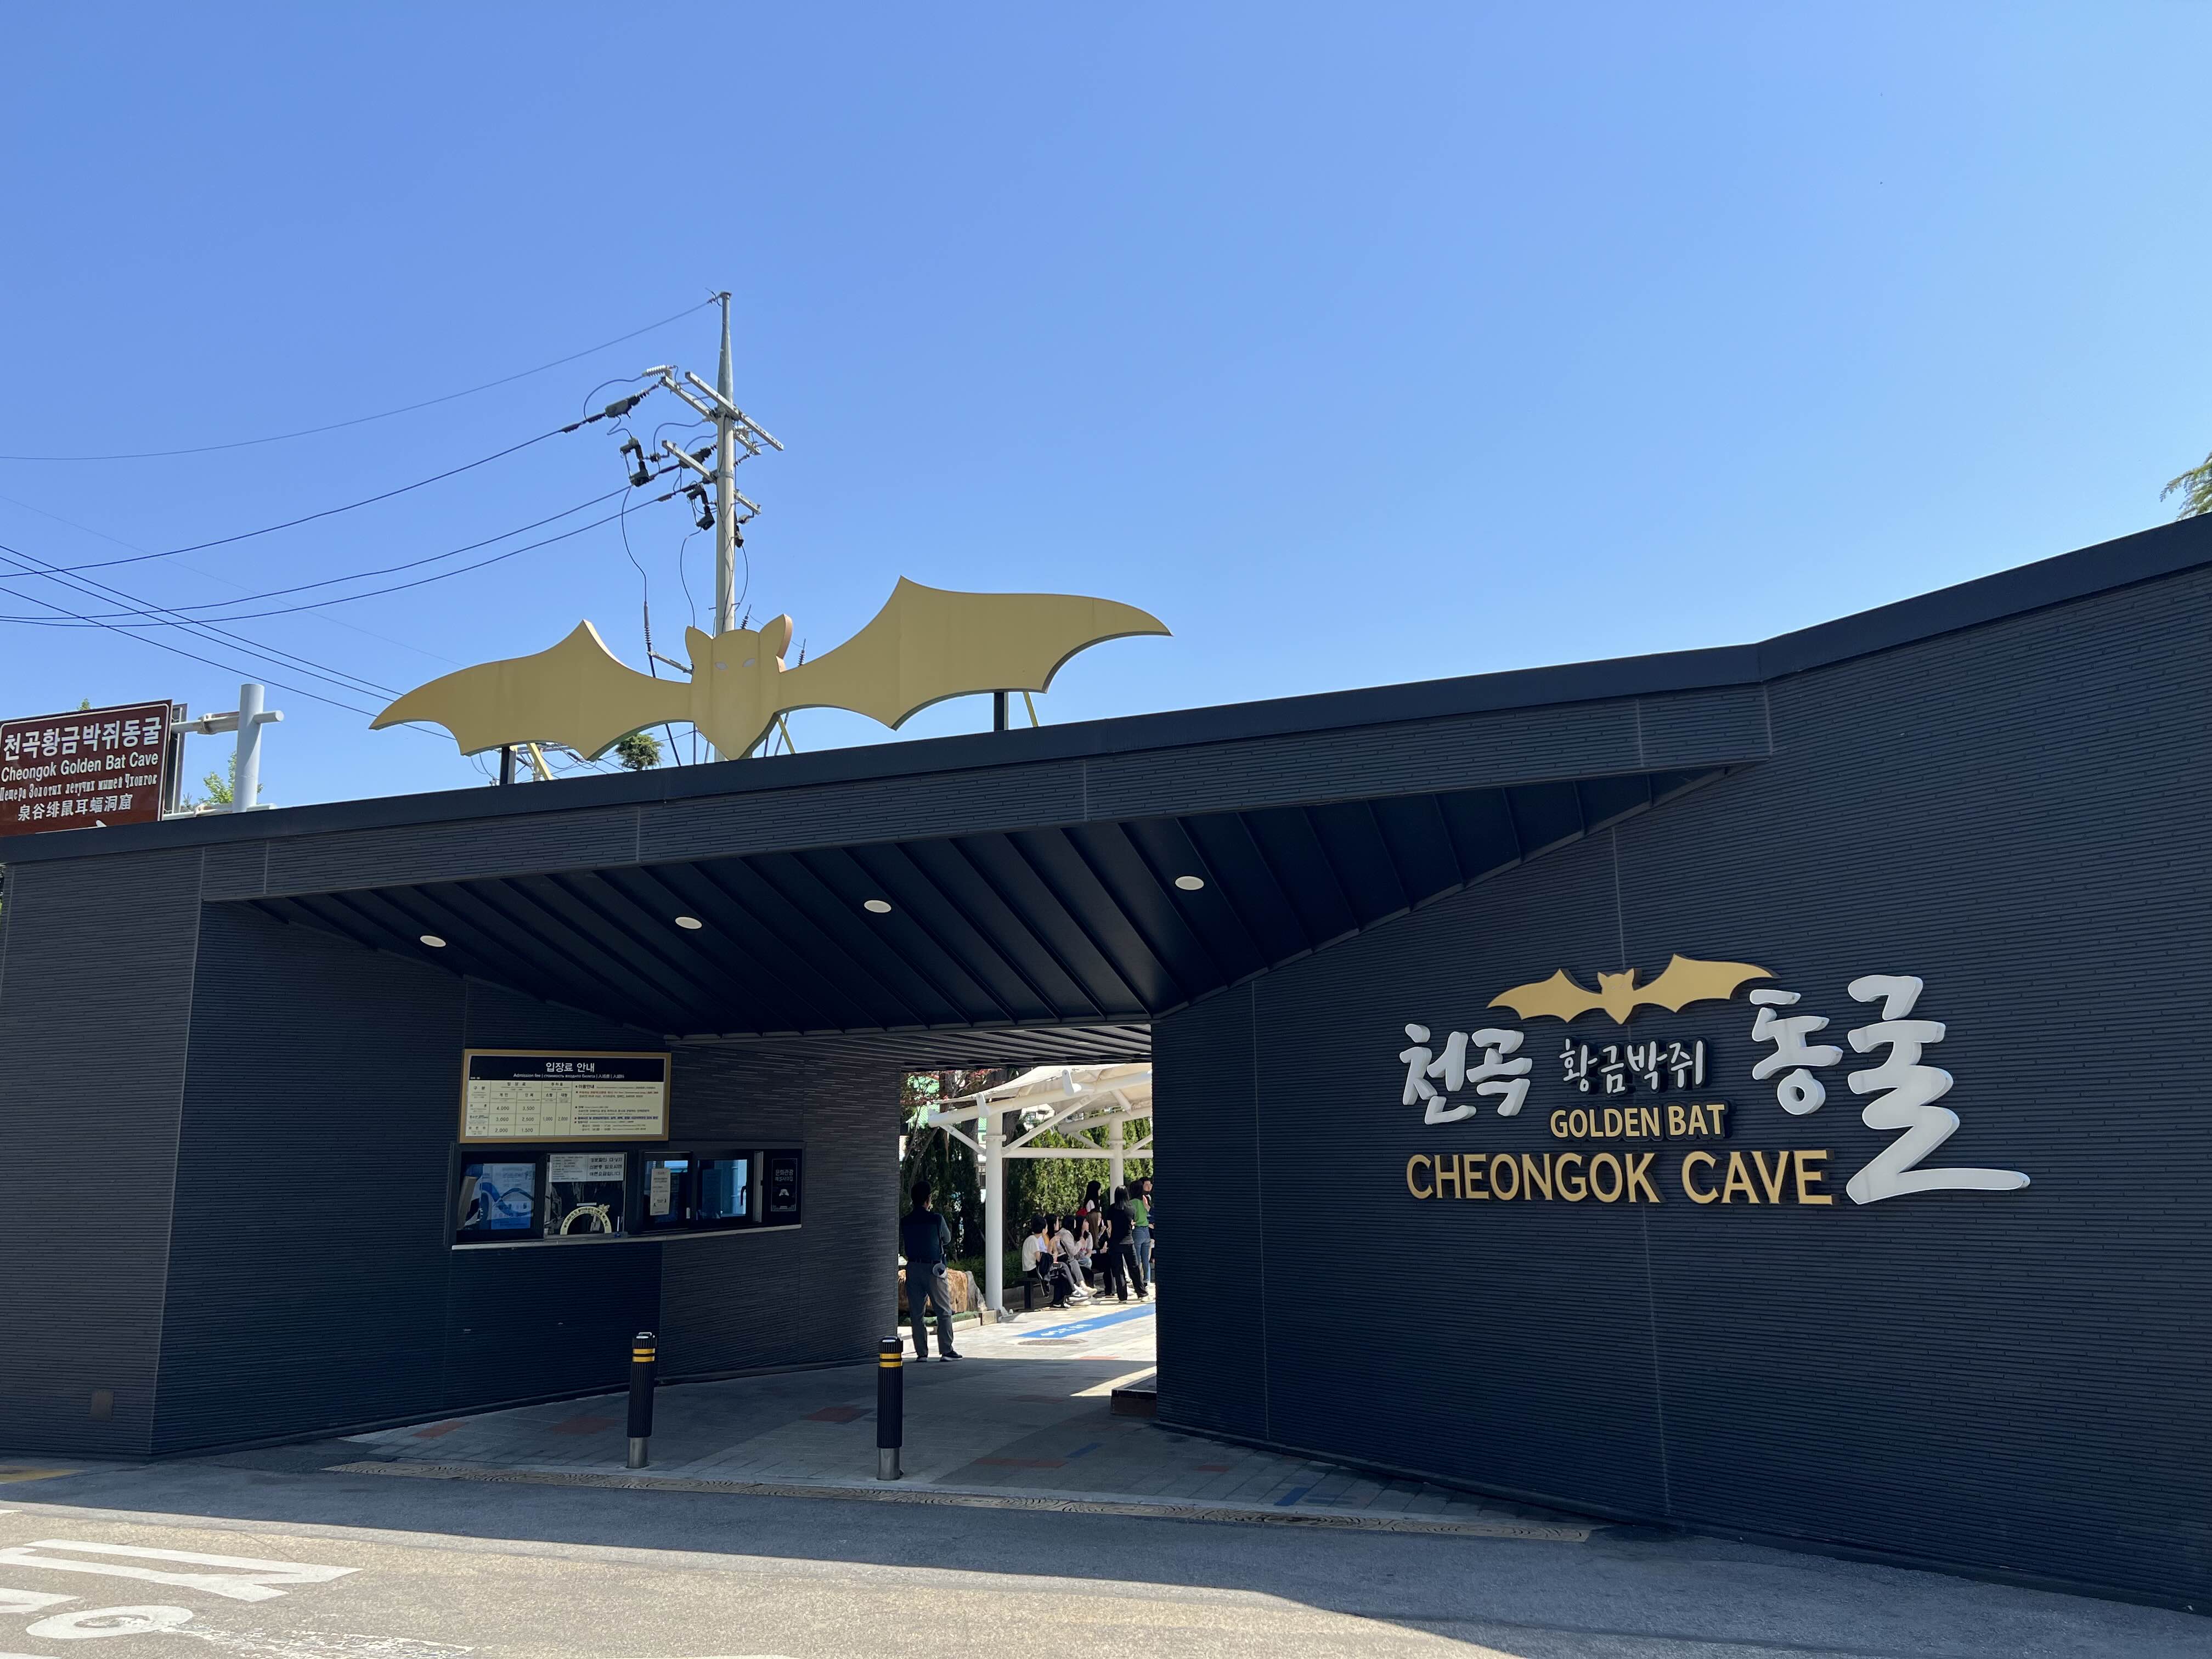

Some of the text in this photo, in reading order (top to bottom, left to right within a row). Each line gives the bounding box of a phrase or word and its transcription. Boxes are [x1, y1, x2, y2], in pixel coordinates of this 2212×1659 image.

[3, 716, 162, 761] 천곡황금박쥐동굴
[1, 752, 159, 782] Cheongok Golden Bat Cave
[546, 1062, 595, 1073] 입장료 안내
[1400, 974, 2031, 1205] 천곡 황금박쥐 동굴
[1550, 1104, 1727, 1139] GOLDEN BAT
[1406, 1149, 1834, 1206] CHEONGOK CAVE
